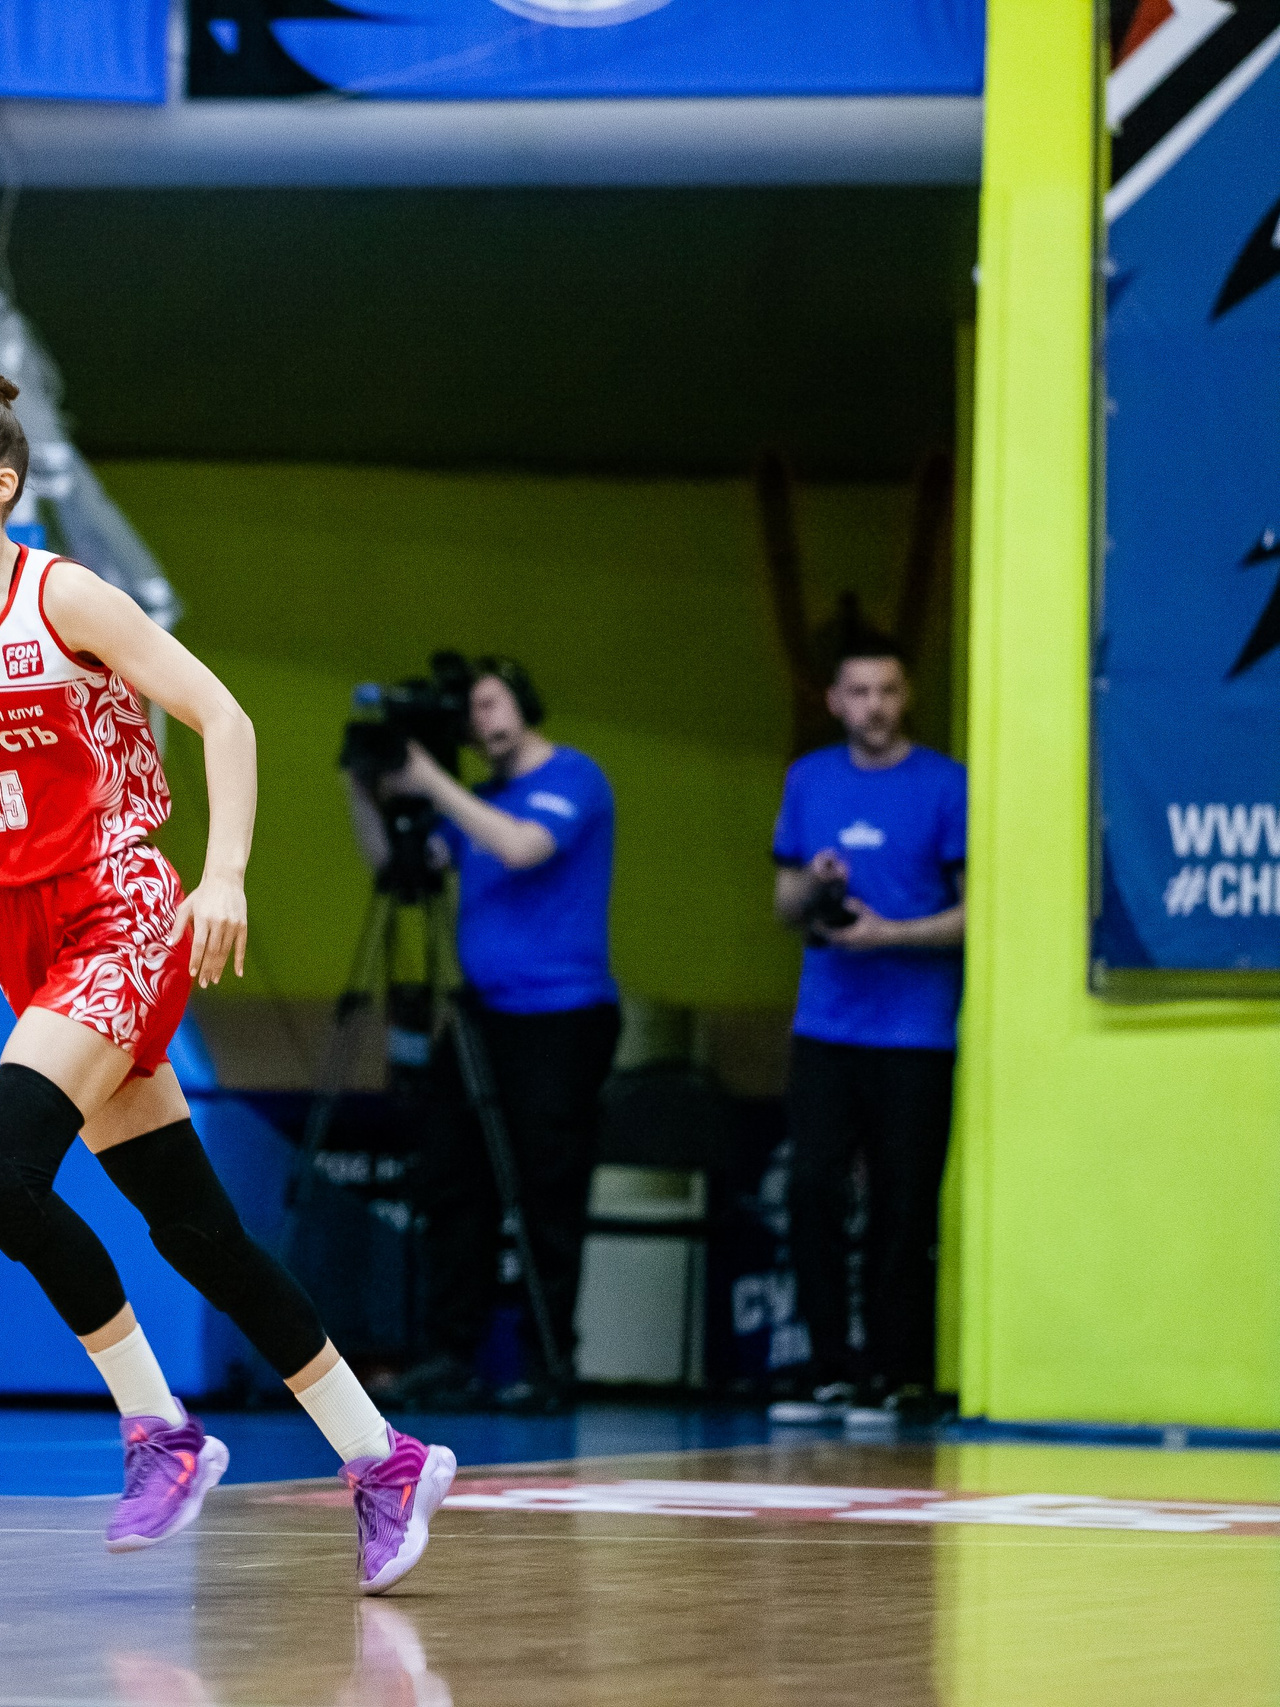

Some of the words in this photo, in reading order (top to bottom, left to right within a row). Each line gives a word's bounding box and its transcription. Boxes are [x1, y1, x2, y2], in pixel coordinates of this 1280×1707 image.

[6, 643, 38, 661] FON
[9, 656, 40, 675] BET
[7, 704, 44, 721] КЛУБ
[1163, 862, 1280, 917] #CH
